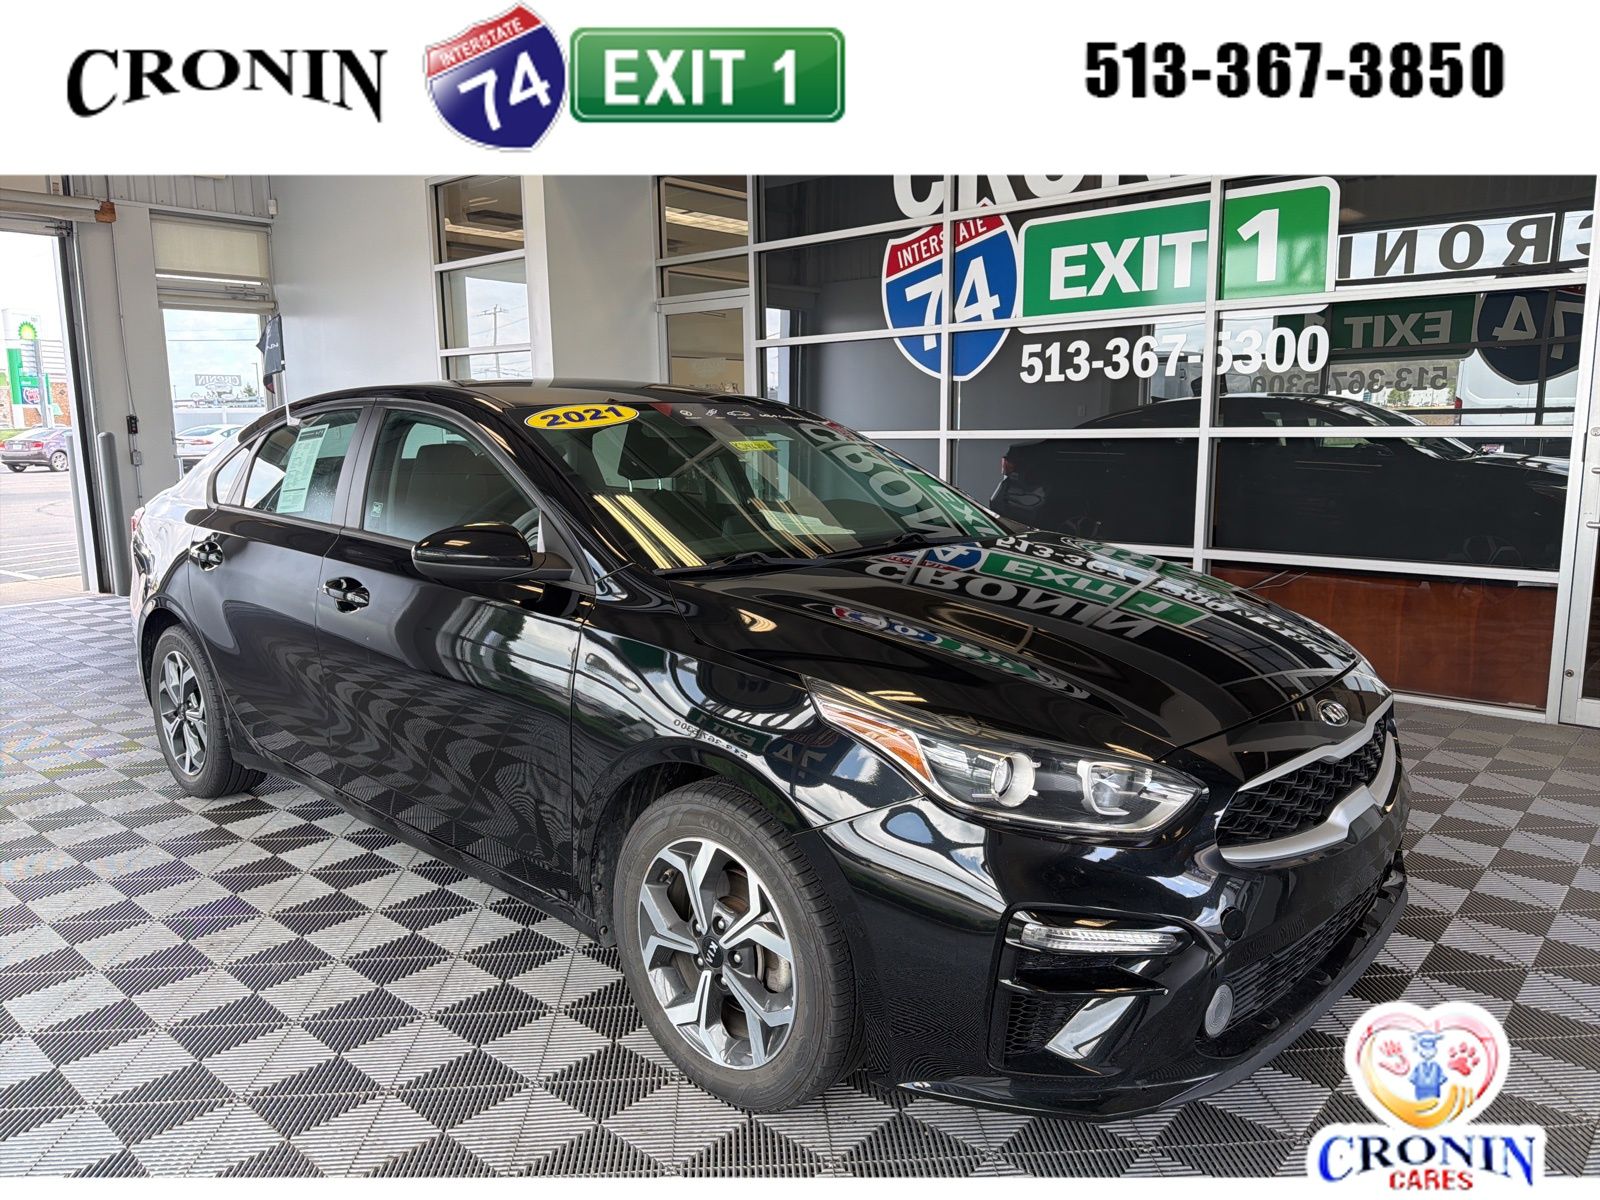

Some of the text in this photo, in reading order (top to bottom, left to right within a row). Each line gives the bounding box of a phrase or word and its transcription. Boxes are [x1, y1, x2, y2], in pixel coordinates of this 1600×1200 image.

[897, 215, 987, 269] INTERSATE
[1050, 208, 1279, 300] EXIT 1
[904, 255, 1001, 352] 74
[540, 406, 622, 427] 2021
[705, 941, 718, 964] KIA
